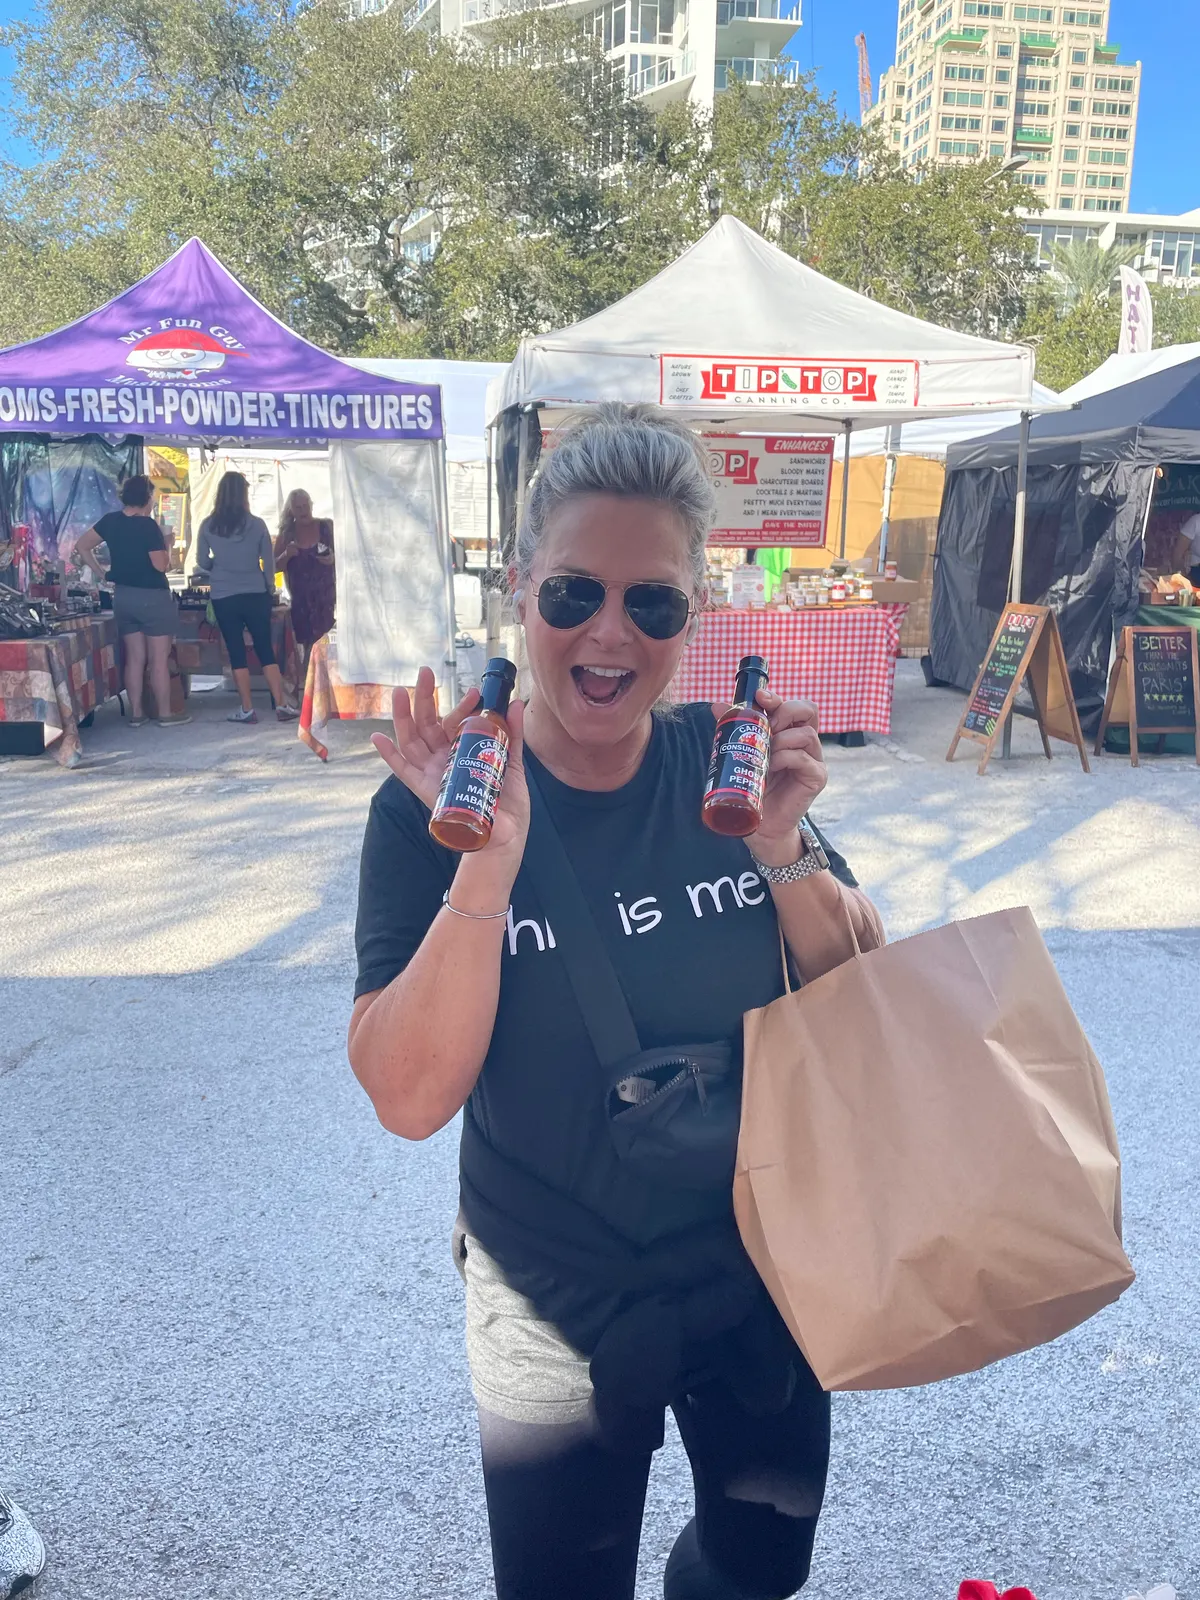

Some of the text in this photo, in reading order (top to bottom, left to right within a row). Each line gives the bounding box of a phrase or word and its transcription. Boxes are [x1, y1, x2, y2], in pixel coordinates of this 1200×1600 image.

[1126, 284, 1140, 353] HAT
[117, 318, 245, 349] Mr Fun Guy
[105, 374, 232, 388] Mushrooms
[715, 367, 864, 393] TIP TOP
[734, 395, 847, 406] CANNING CO.
[773, 440, 829, 451] ENHANCES
[710, 452, 746, 473] OP
[789, 457, 826, 465] SANDWICHES
[756, 488, 788, 496] COCKTAILS
[734, 766, 761, 781] GHOS
[729, 775, 761, 791] PEPPE
[467, 784, 497, 807] MANGO
[455, 793, 496, 817] HABANE
[614, 891, 663, 936] is
[685, 871, 766, 918] me
